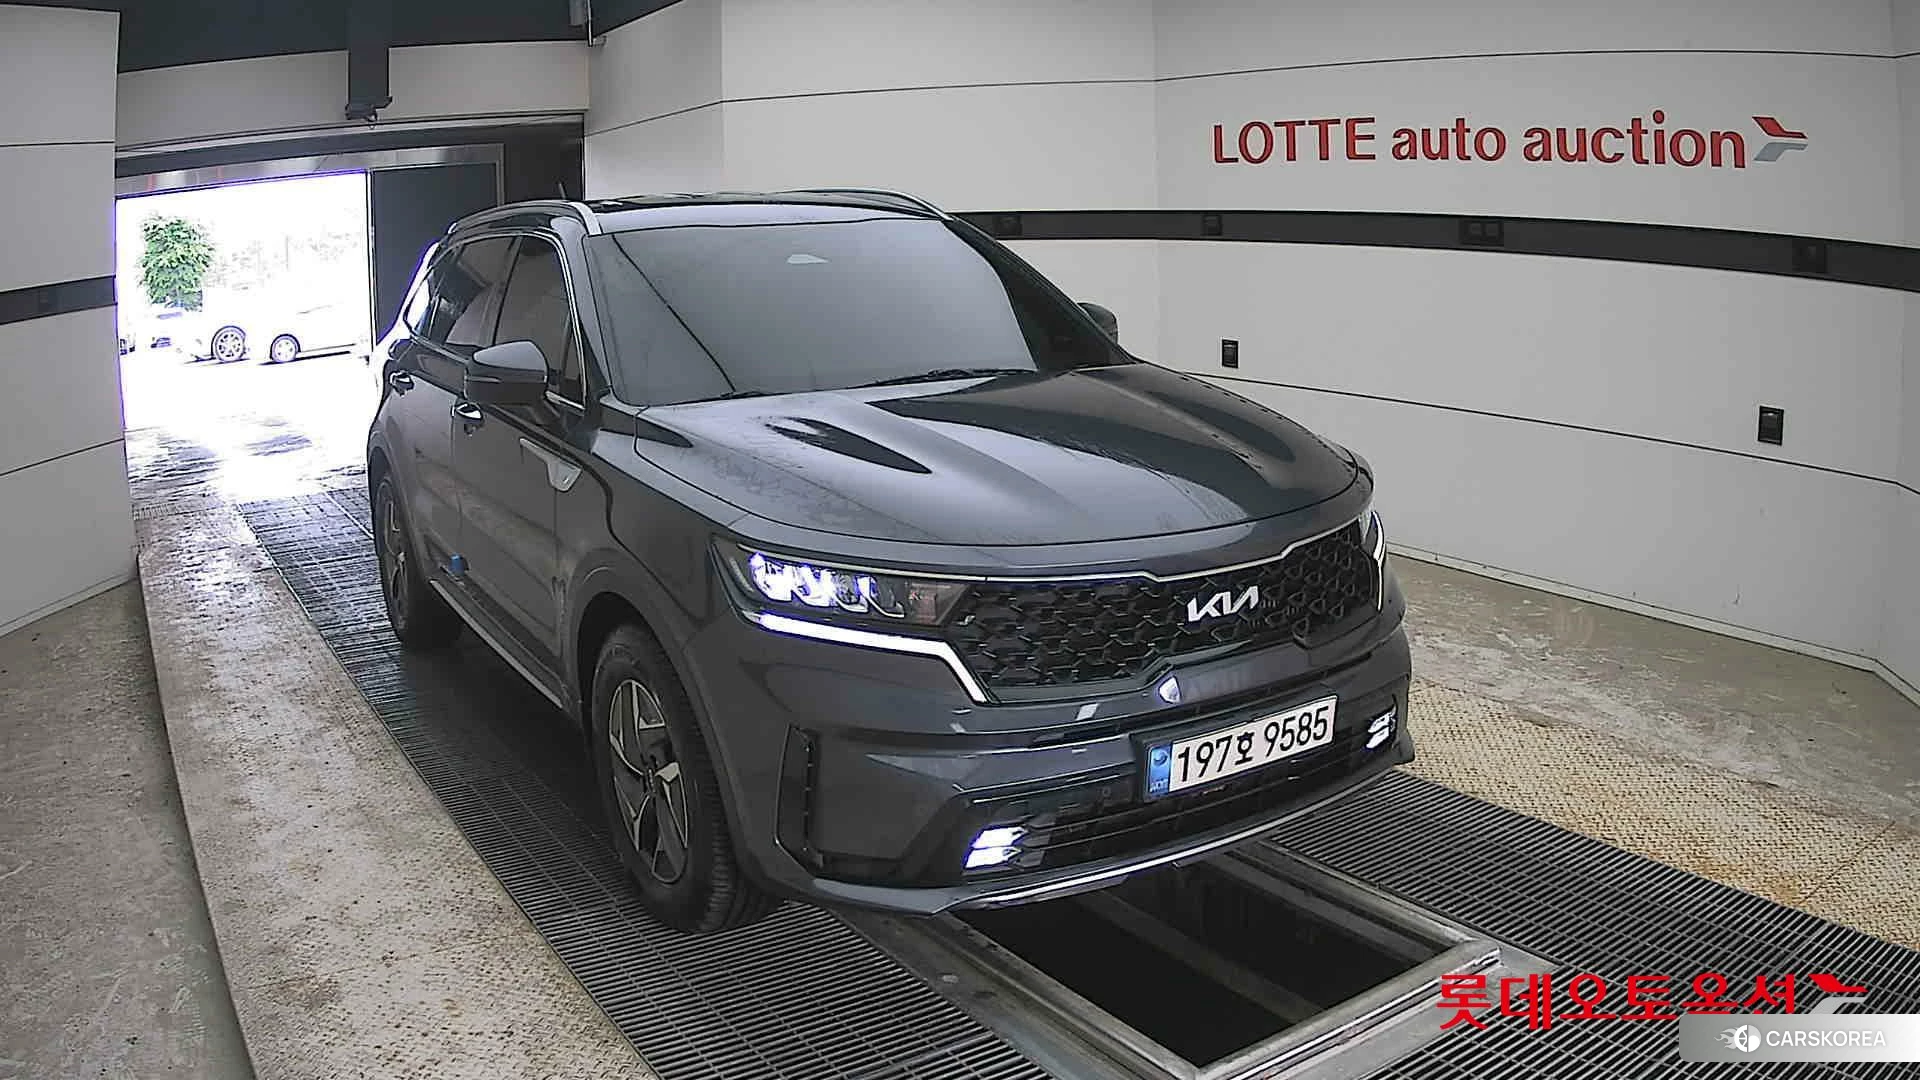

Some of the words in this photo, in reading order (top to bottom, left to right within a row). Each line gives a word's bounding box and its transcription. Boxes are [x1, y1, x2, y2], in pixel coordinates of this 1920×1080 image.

[1213, 118, 1376, 164] LOTTE
[1392, 118, 1507, 161] auto
[1523, 110, 1746, 168] auction
[1187, 585, 1259, 622] KIA
[1178, 732, 1254, 782] 197호
[1264, 707, 1328, 757] 9585
